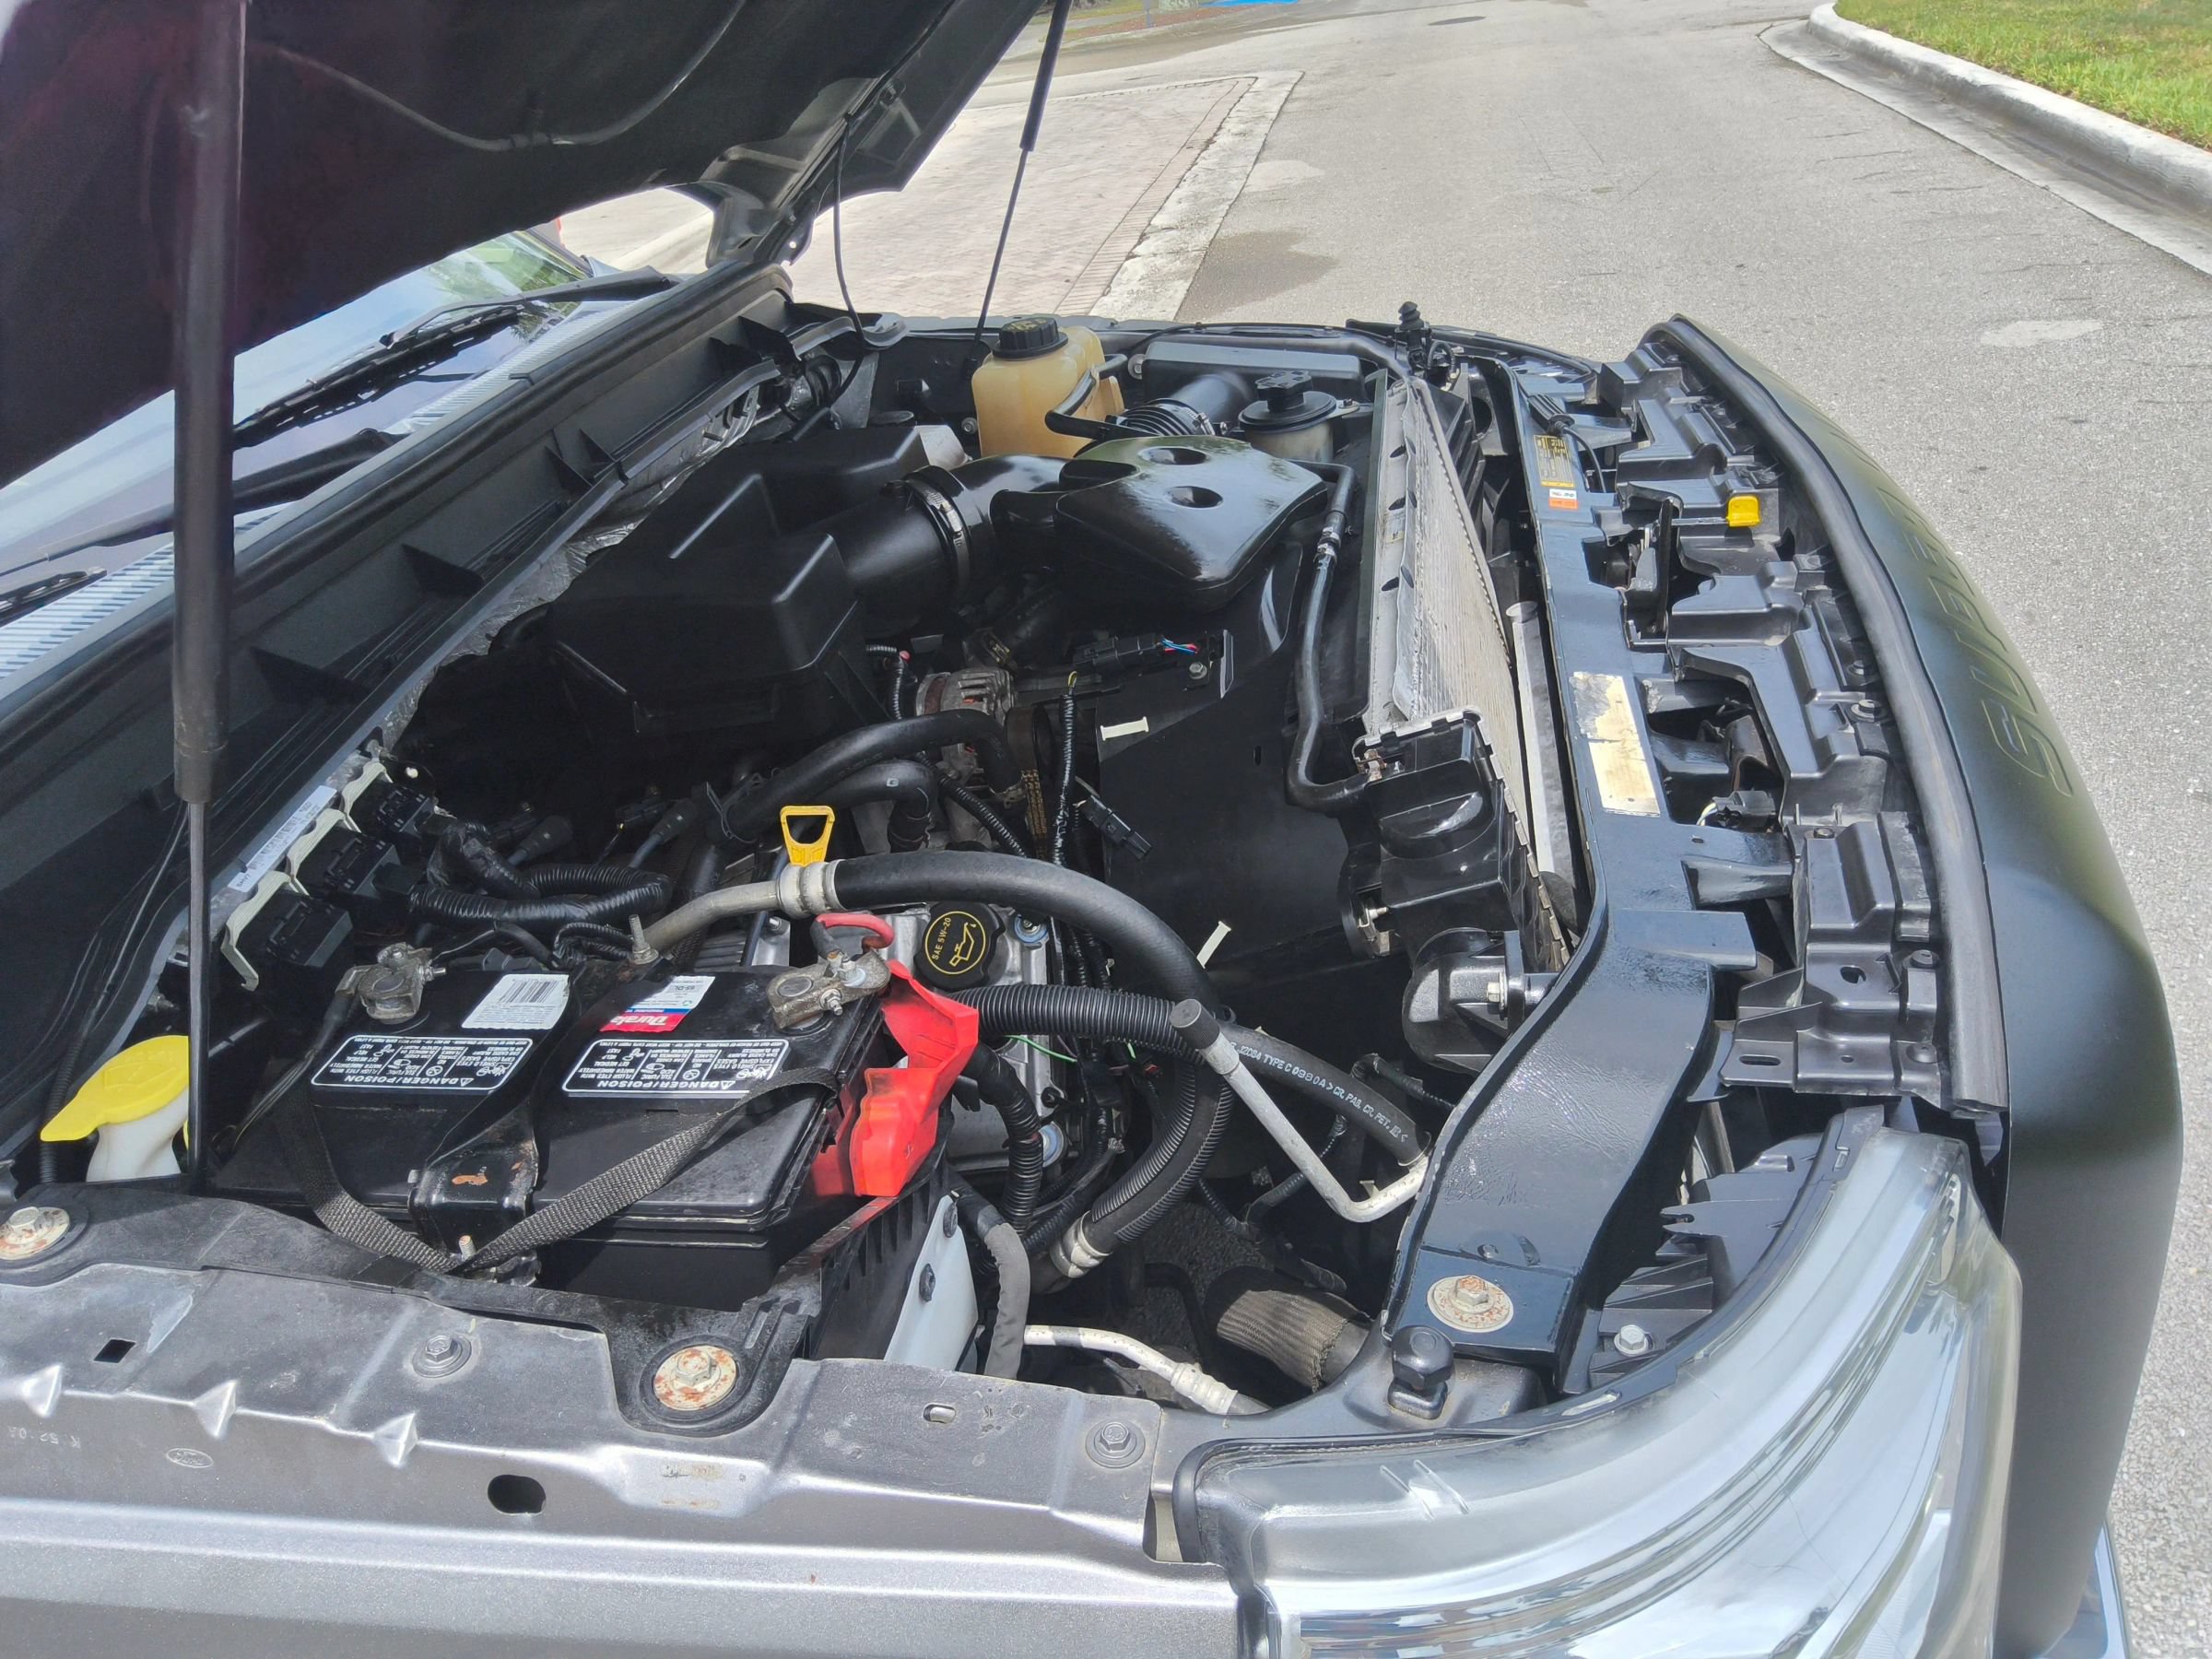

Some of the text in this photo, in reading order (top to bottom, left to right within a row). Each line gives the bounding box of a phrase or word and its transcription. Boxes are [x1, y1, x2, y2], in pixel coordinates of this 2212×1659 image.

[932, 917, 951, 960] SAE 5W-20
[610, 1015, 668, 1026] Durala
[1264, 1053, 1286, 1069] TYPE
[345, 1076, 459, 1085] DANGER/POISON
[596, 1080, 722, 1088] DANGER/POISON
